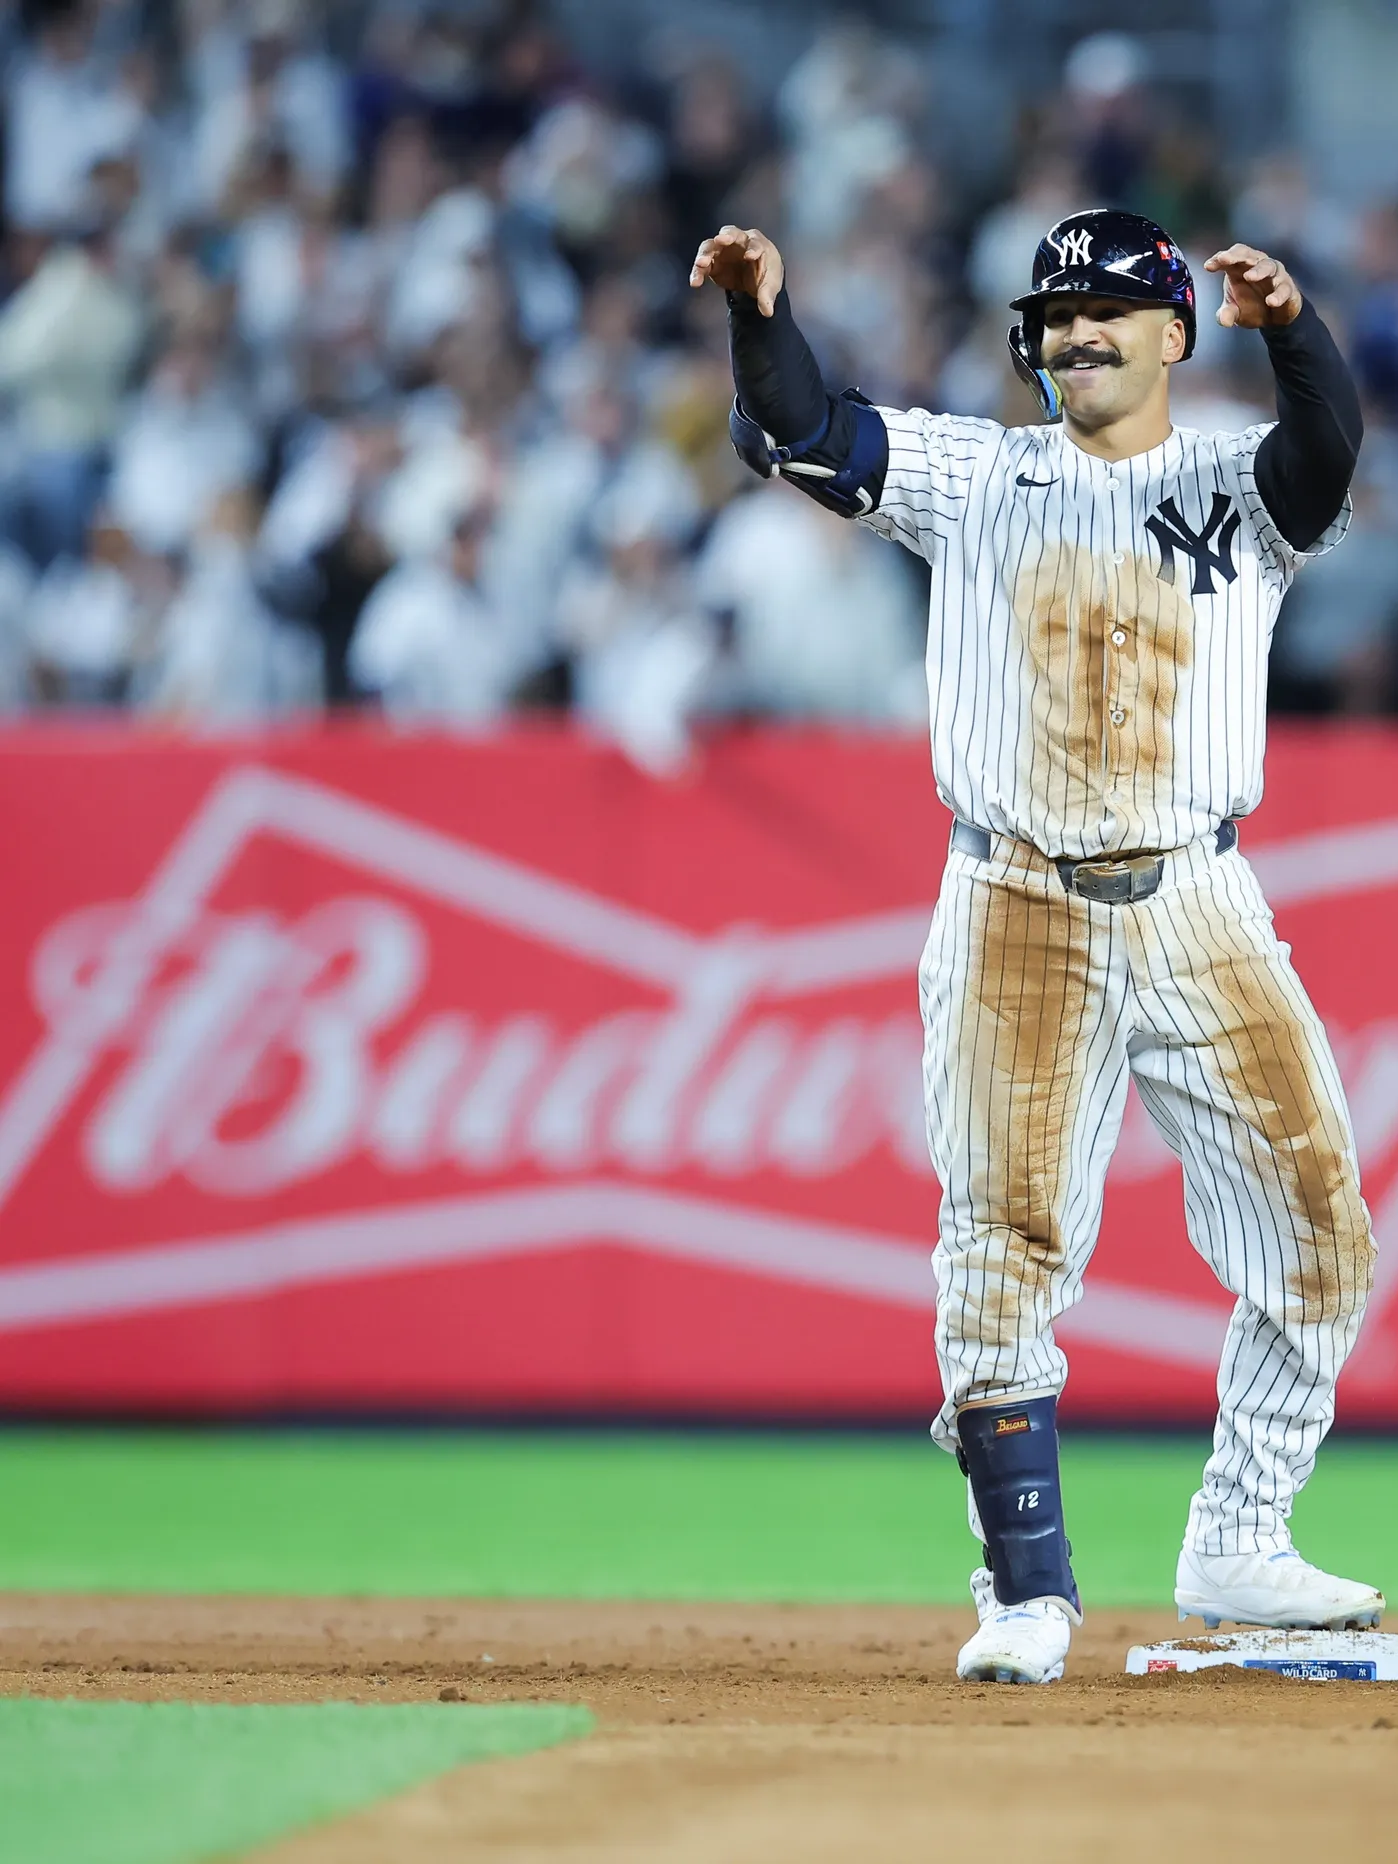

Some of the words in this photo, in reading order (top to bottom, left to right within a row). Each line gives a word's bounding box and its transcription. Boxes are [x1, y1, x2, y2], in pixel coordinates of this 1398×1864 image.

[1059, 229, 1094, 268] NY
[1144, 491, 1242, 595] NY
[1017, 1490, 1040, 1512] 12
[1310, 1667, 1338, 1678] CARD
